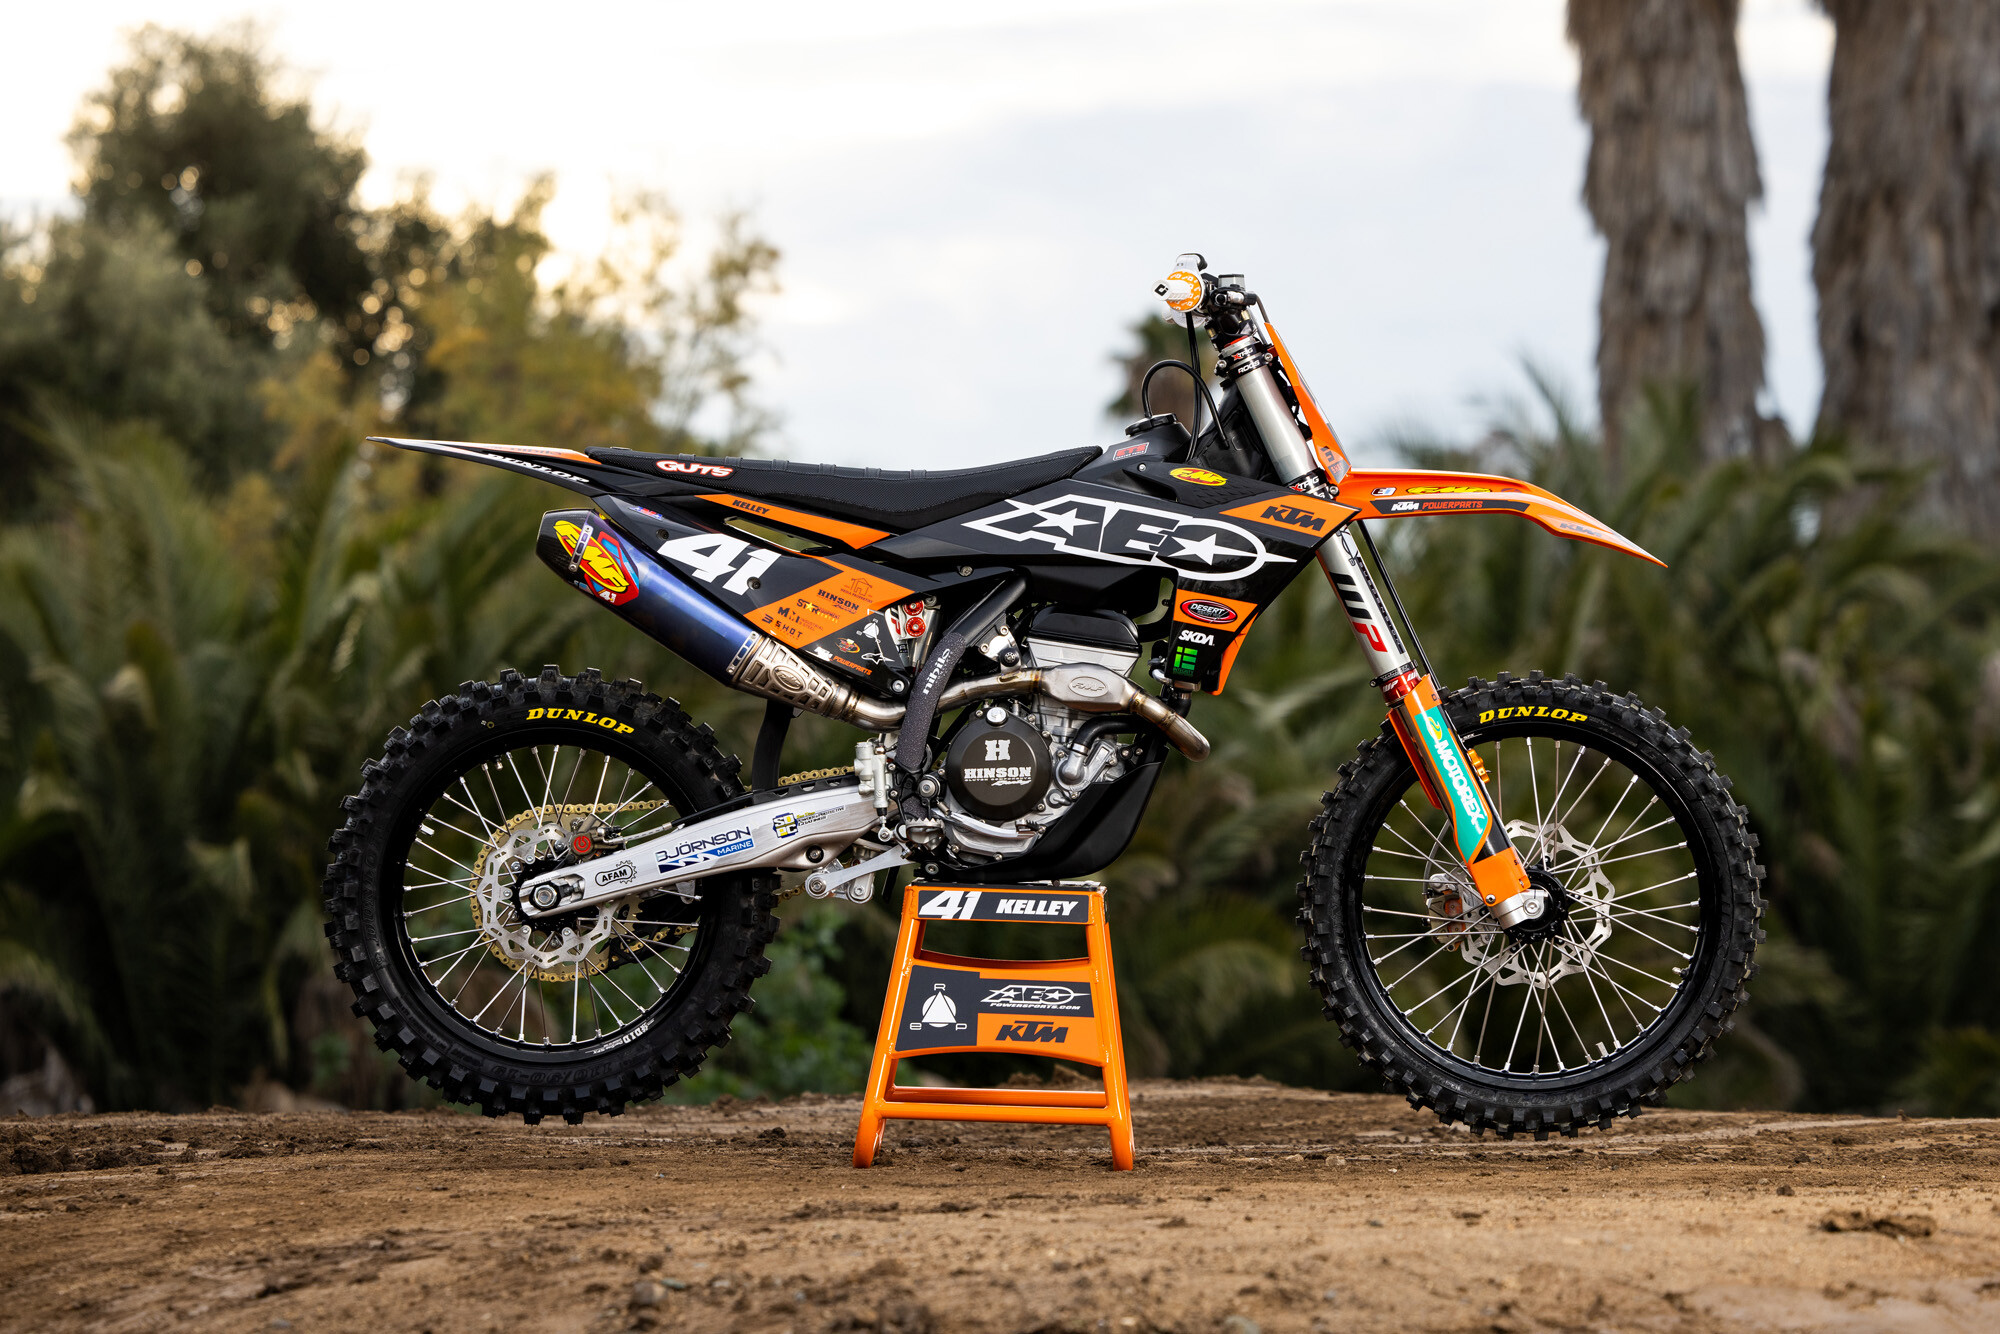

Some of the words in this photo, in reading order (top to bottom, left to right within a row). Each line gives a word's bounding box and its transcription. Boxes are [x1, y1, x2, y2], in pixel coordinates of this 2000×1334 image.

[484, 452, 590, 485] DUNLOP
[656, 460, 734, 478] GUTS
[732, 499, 770, 515] KELLEY
[1391, 501, 1420, 511] KTM
[1422, 500, 1484, 510] POWERPARTS
[1261, 504, 1326, 532] KTM
[657, 533, 782, 596] 41
[818, 589, 860, 611] HINSON
[1190, 603, 1225, 615] DESERT
[1178, 629, 1215, 646] SKDA
[526, 707, 635, 735] DUNLOP
[1479, 705, 1588, 724] DUNLOP
[984, 739, 1011, 761] H
[964, 766, 1032, 779] HINSON
[1434, 739, 1486, 835] MOTOREX
[655, 826, 751, 863] BJÖRNSON
[717, 840, 752, 856] MARINE
[601, 869, 628, 882] AFAM
[918, 890, 983, 920] 41
[995, 898, 1079, 917] KELLEY
[933, 983, 946, 991] R
[989, 1002, 1081, 1011] POWERSPORTS.COM
[955, 1023, 967, 1031] P
[994, 1020, 1069, 1044] KTM
